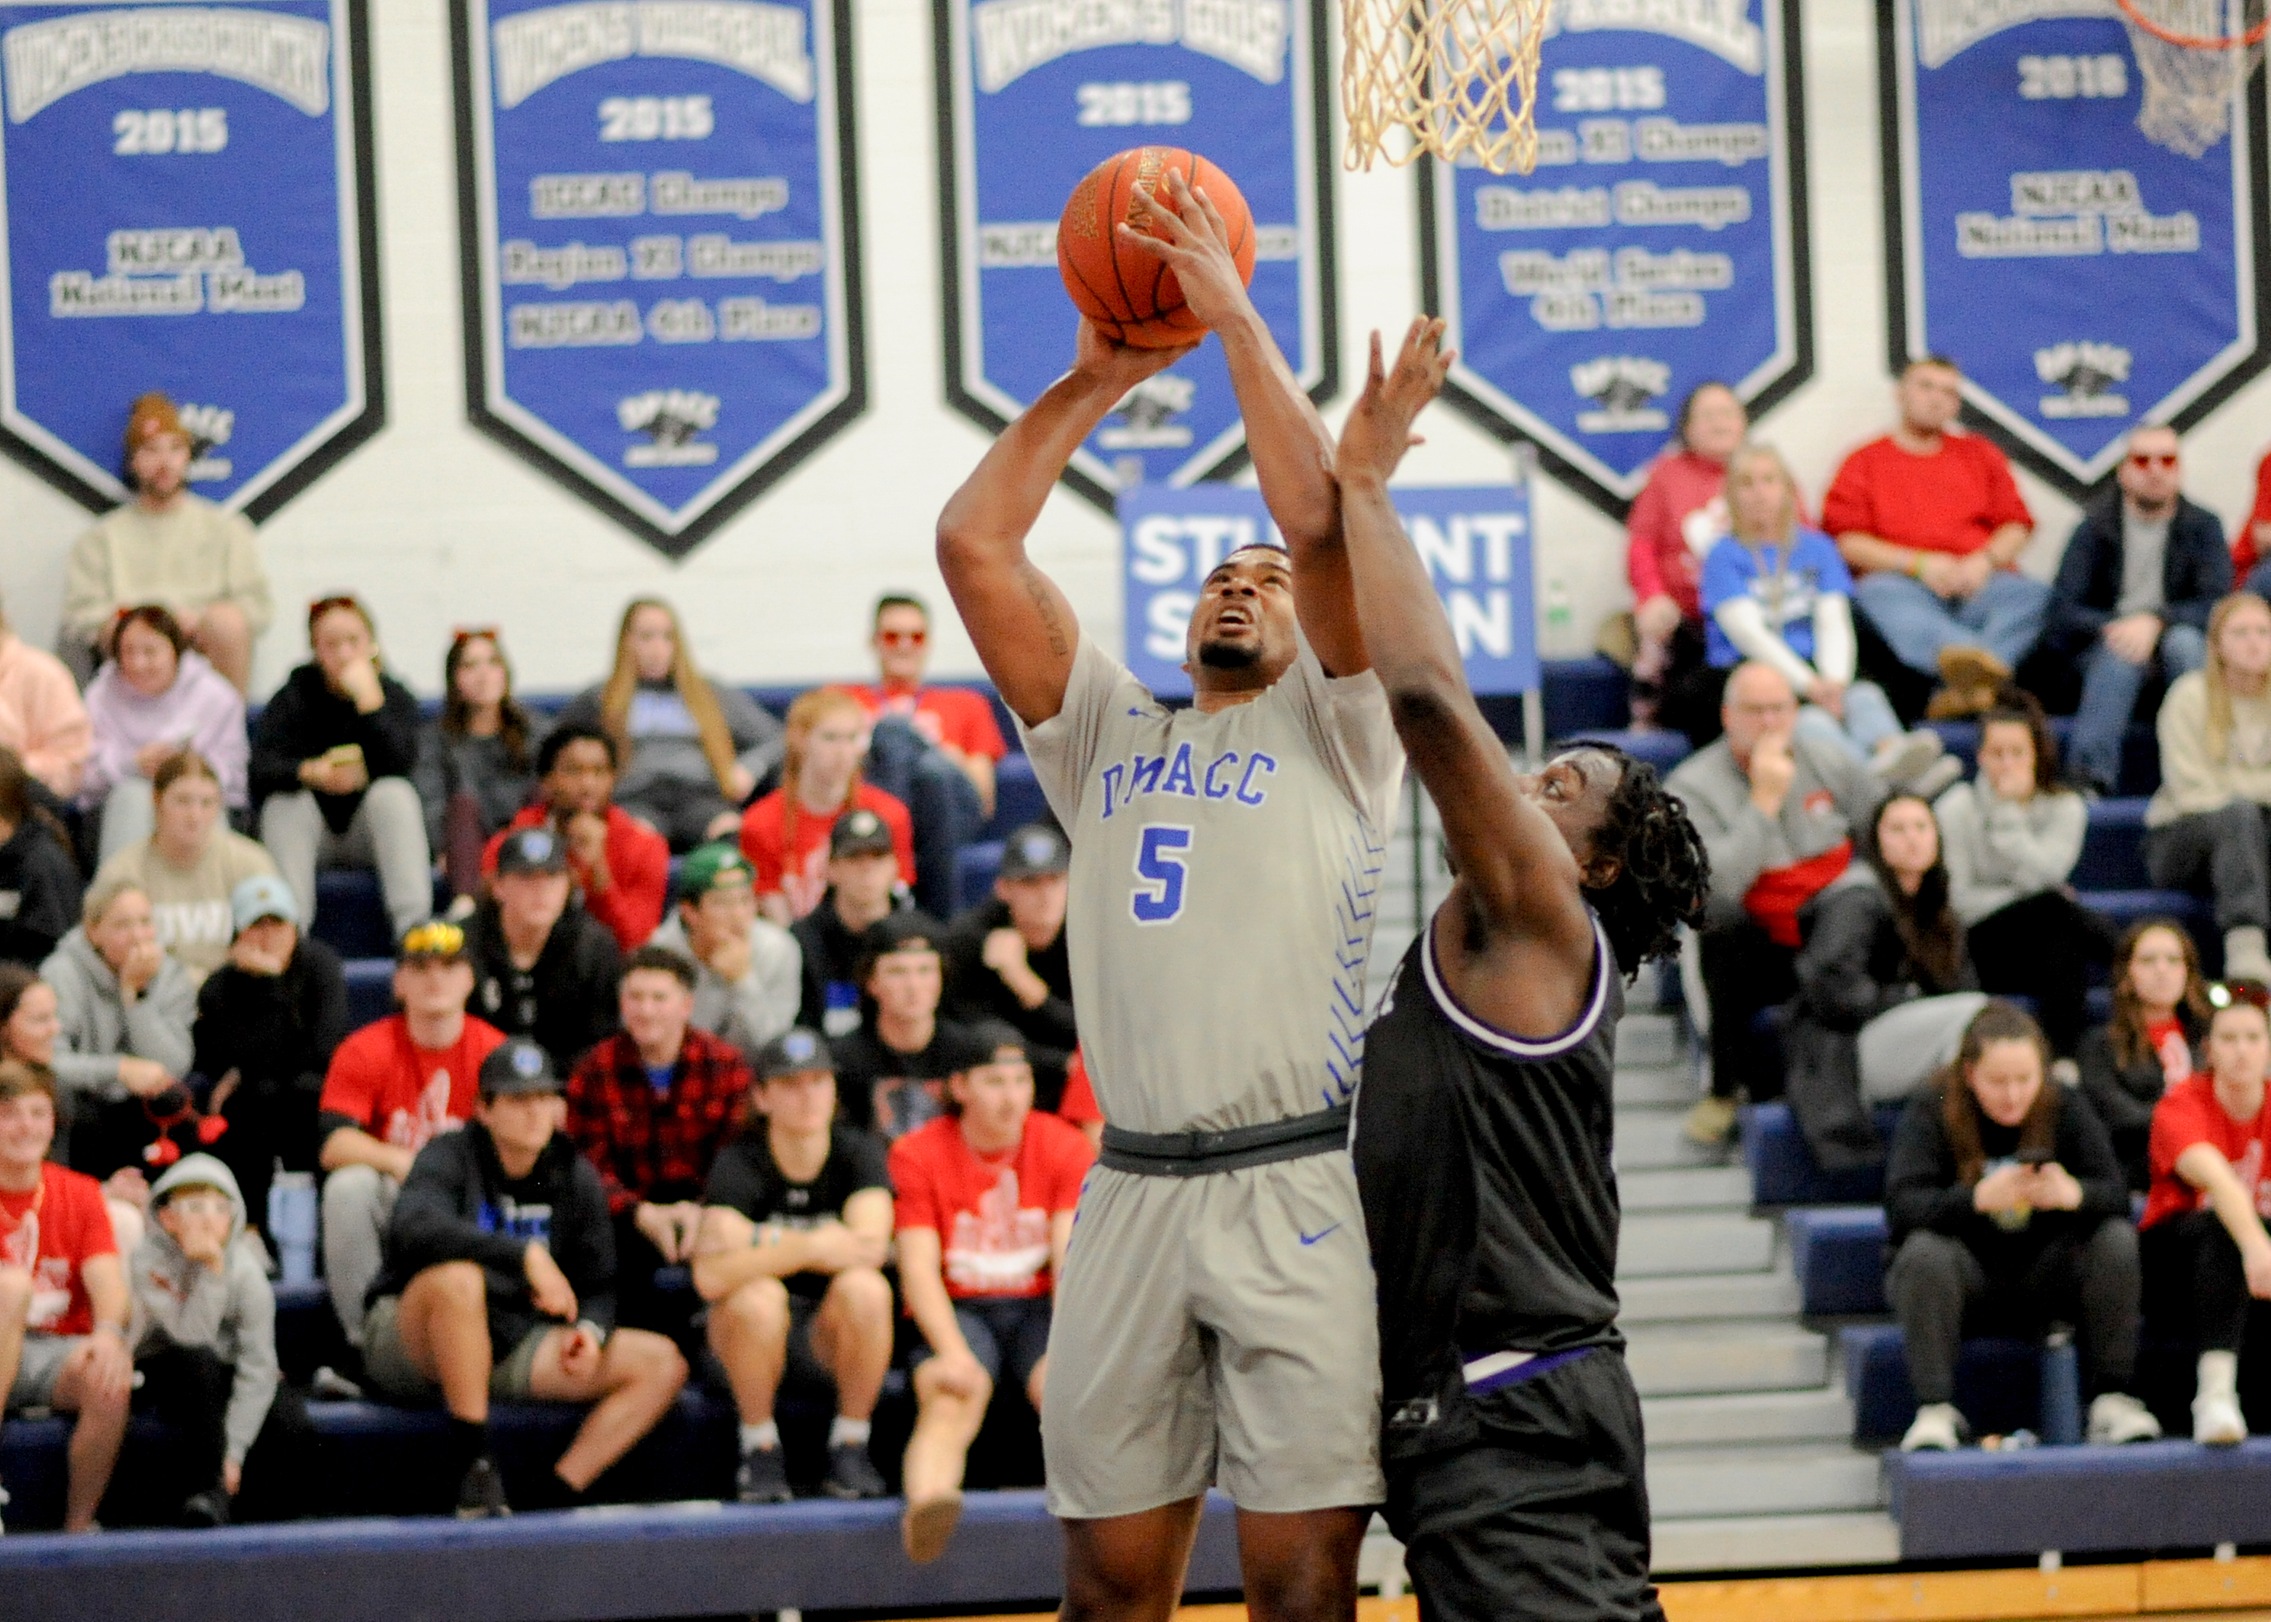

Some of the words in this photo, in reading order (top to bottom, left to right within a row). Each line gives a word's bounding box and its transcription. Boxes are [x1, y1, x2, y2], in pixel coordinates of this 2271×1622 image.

[112, 108, 228, 156] 2015
[598, 96, 714, 142] 2015
[111, 230, 242, 270] NJCAA
[53, 273, 200, 315] National
[1133, 514, 1526, 584] STNT
[1131, 822, 1194, 926] 5
